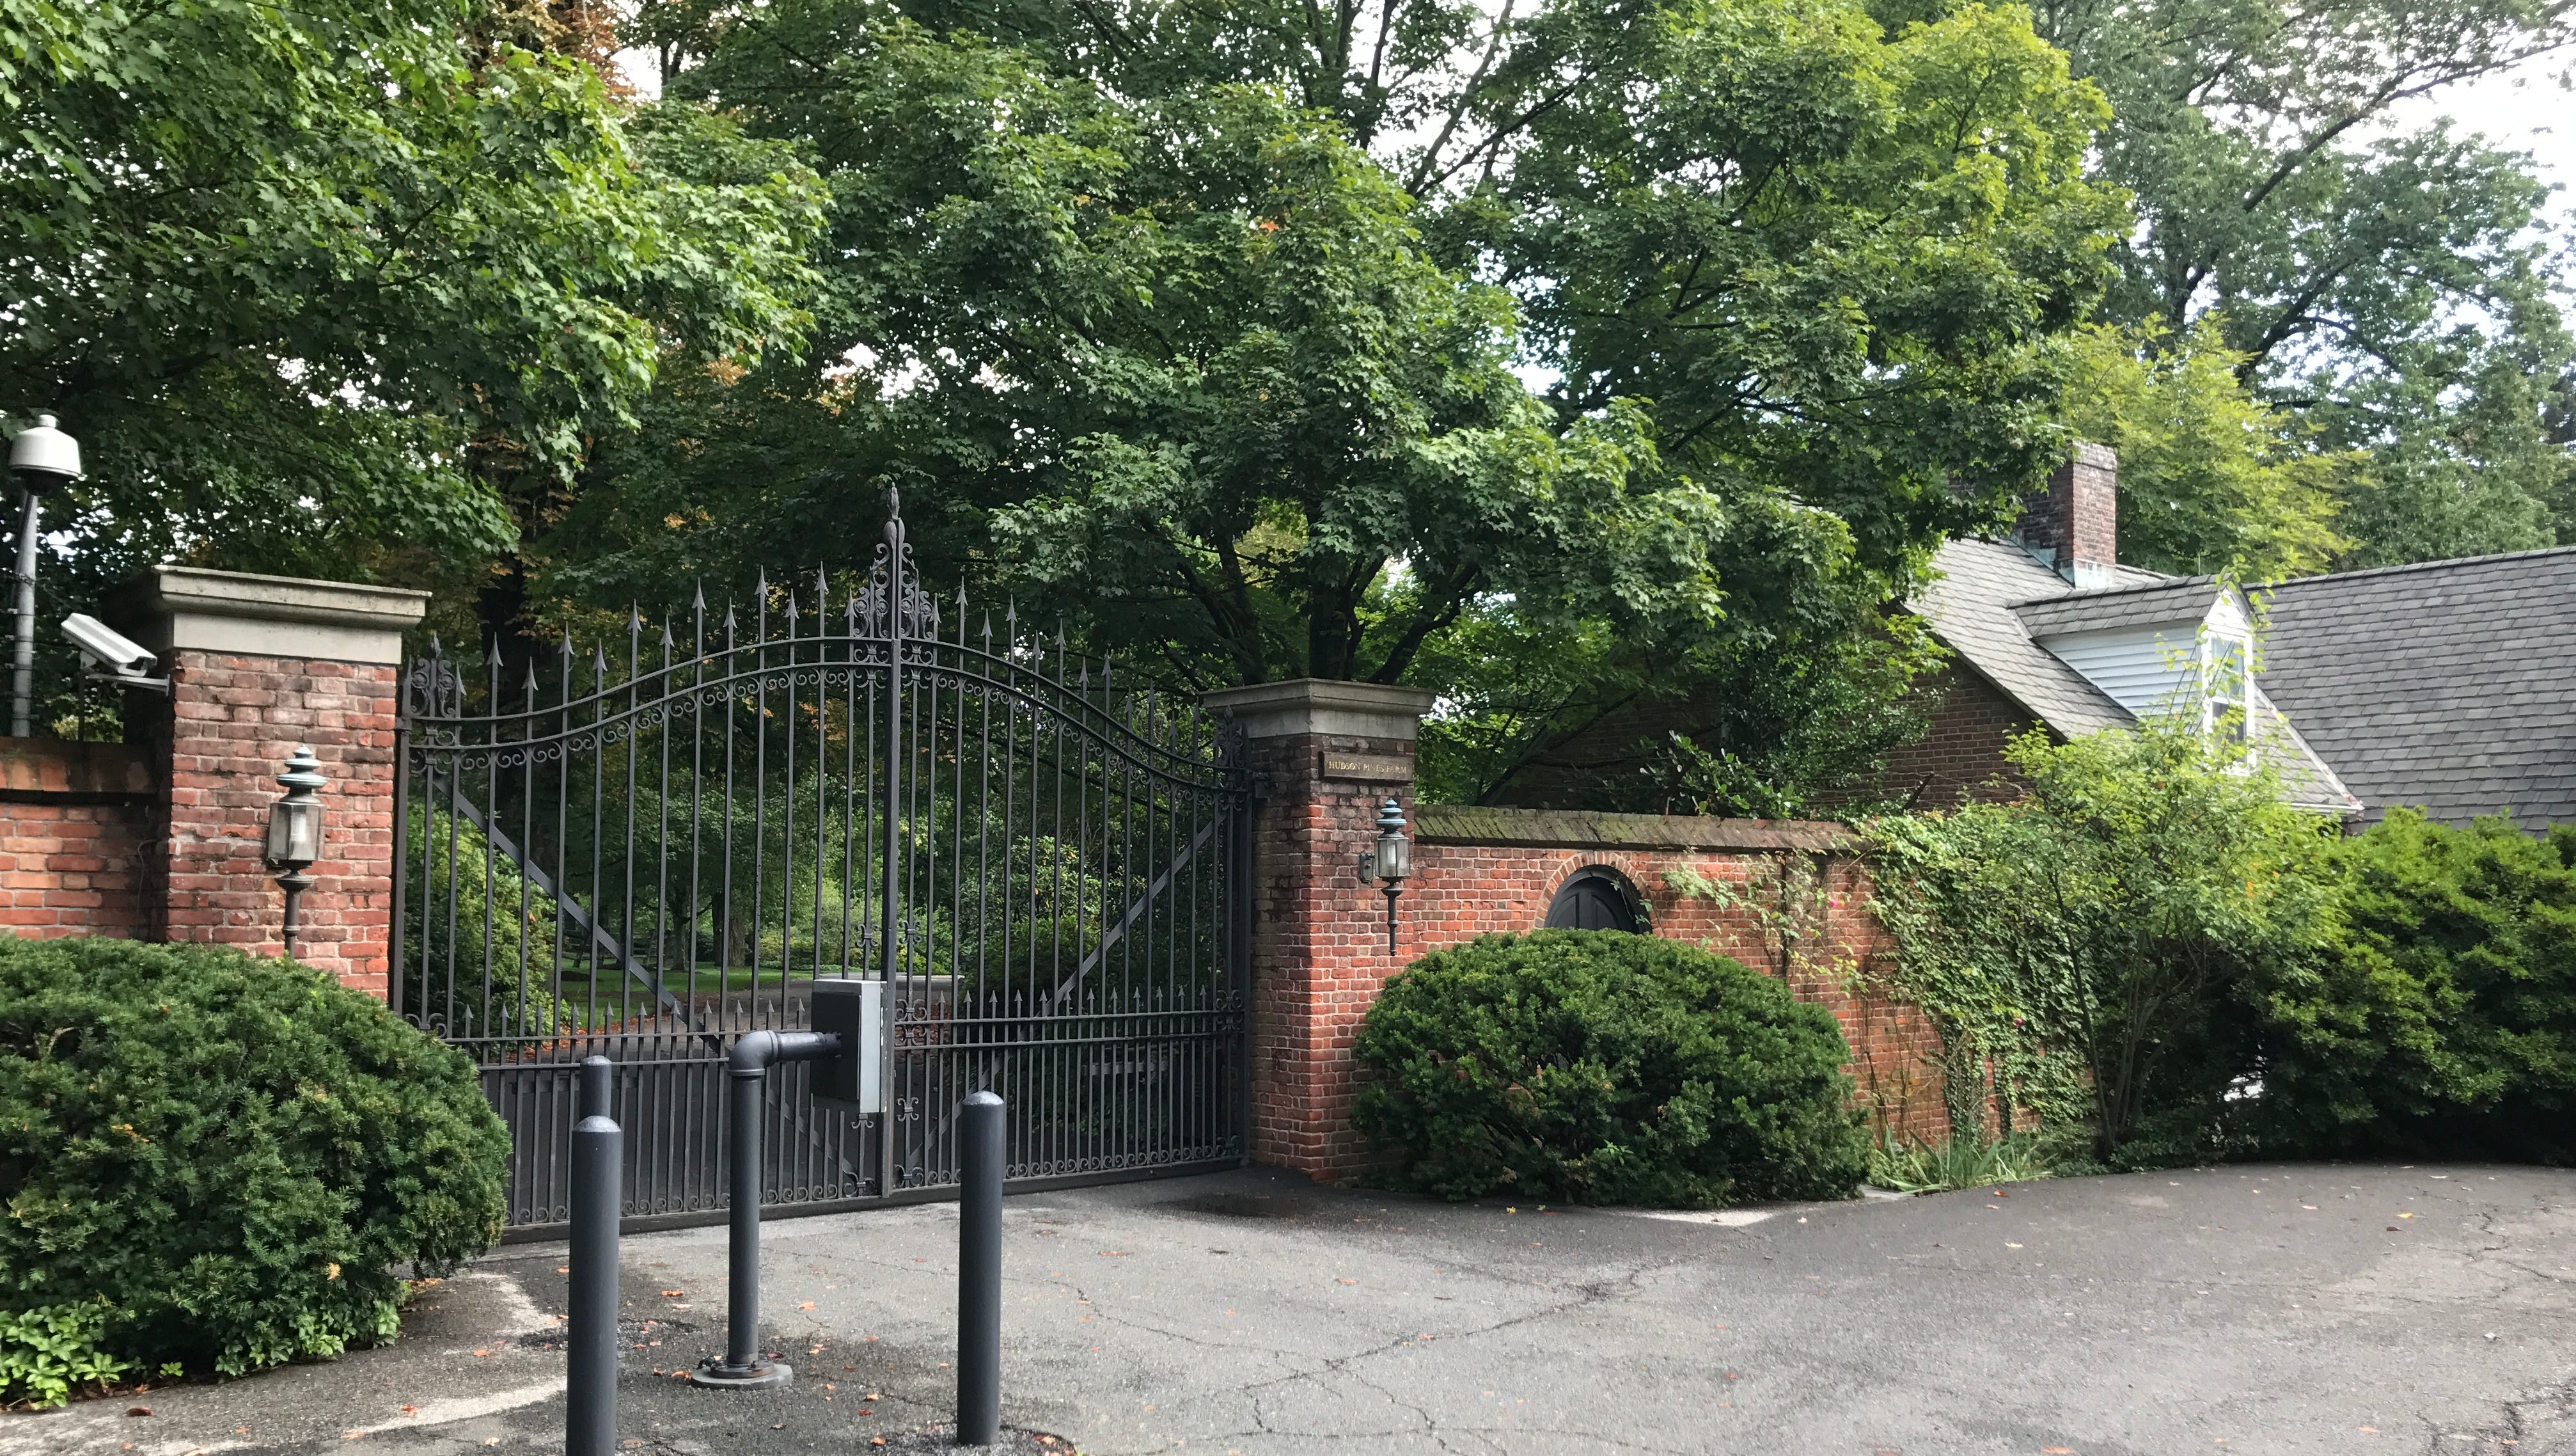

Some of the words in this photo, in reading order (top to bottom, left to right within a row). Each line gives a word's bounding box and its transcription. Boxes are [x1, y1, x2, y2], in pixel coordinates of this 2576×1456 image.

[1329, 761, 1361, 770] HUDSON
[1363, 763, 1385, 772] PINES
[1386, 765, 1407, 773] FARM
